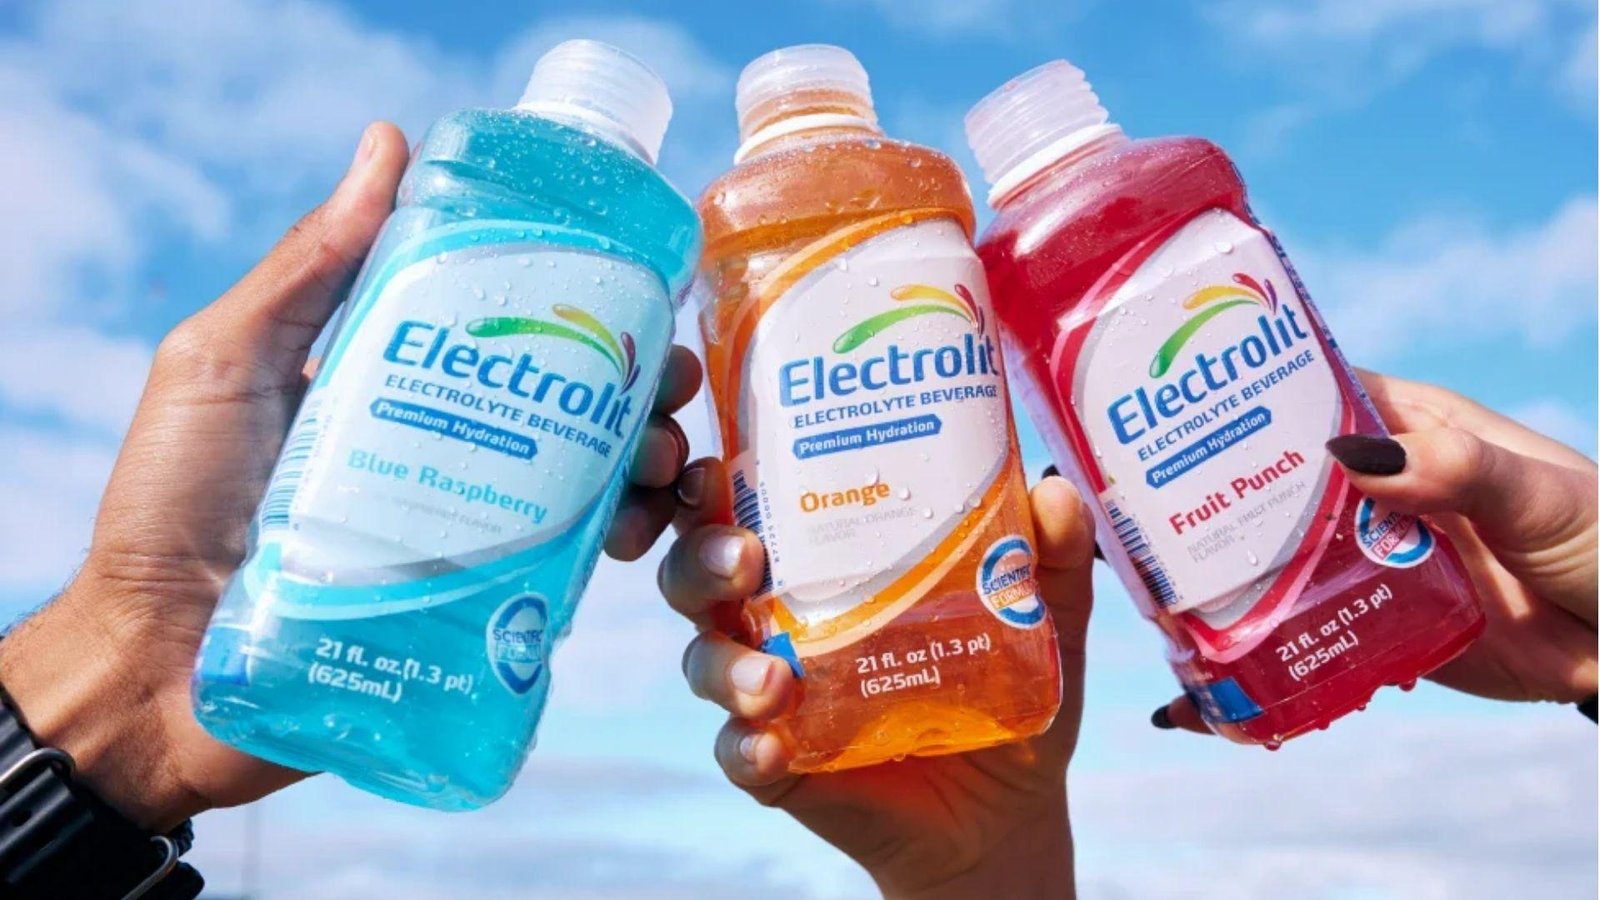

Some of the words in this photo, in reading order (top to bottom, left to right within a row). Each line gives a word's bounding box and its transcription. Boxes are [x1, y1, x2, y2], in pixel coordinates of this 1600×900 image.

[383, 320, 631, 438] Electrolit
[779, 333, 998, 407] Electrolit
[1107, 304, 1307, 444] Electrolit
[376, 402, 447, 429] Premium
[452, 421, 530, 455] Hydration
[385, 375, 523, 422] ELECTROLYTE
[528, 413, 612, 458] BEVERAGE
[794, 395, 915, 428] ELECTROLYTE
[920, 384, 997, 405] BEVERAGE
[1138, 395, 1239, 461] ELECTROLYTE
[1241, 350, 1314, 401] BEVERAGE
[800, 435, 862, 454] Premium
[866, 421, 935, 443] Hydration
[1152, 447, 1208, 483] Premium
[1208, 414, 1265, 451] Hydration
[348, 449, 409, 480] Blue
[418, 465, 548, 524] Raspberry
[800, 483, 890, 512] Orange
[1169, 492, 1231, 535] Fruit
[1231, 451, 1305, 499] Punch
[855, 656, 878, 674] 21
[881, 652, 902, 669] fl.
[906, 649, 927, 664] oz
[930, 638, 964, 661] (1.3
[967, 632, 991, 655] pt)
[1276, 641, 1299, 662] 21
[1298, 632, 1319, 649] fl.
[1320, 620, 1340, 636] oz
[1338, 599, 1368, 625] (1.3
[1370, 583, 1393, 609] pt)
[308, 661, 401, 703] (625mL)
[315, 637, 343, 659] 21
[347, 644, 368, 667] fl.
[403, 658, 441, 683] (1.3
[444, 674, 473, 694] pt)
[861, 666, 940, 698] (625mL)
[1288, 630, 1358, 681] (625mL)
